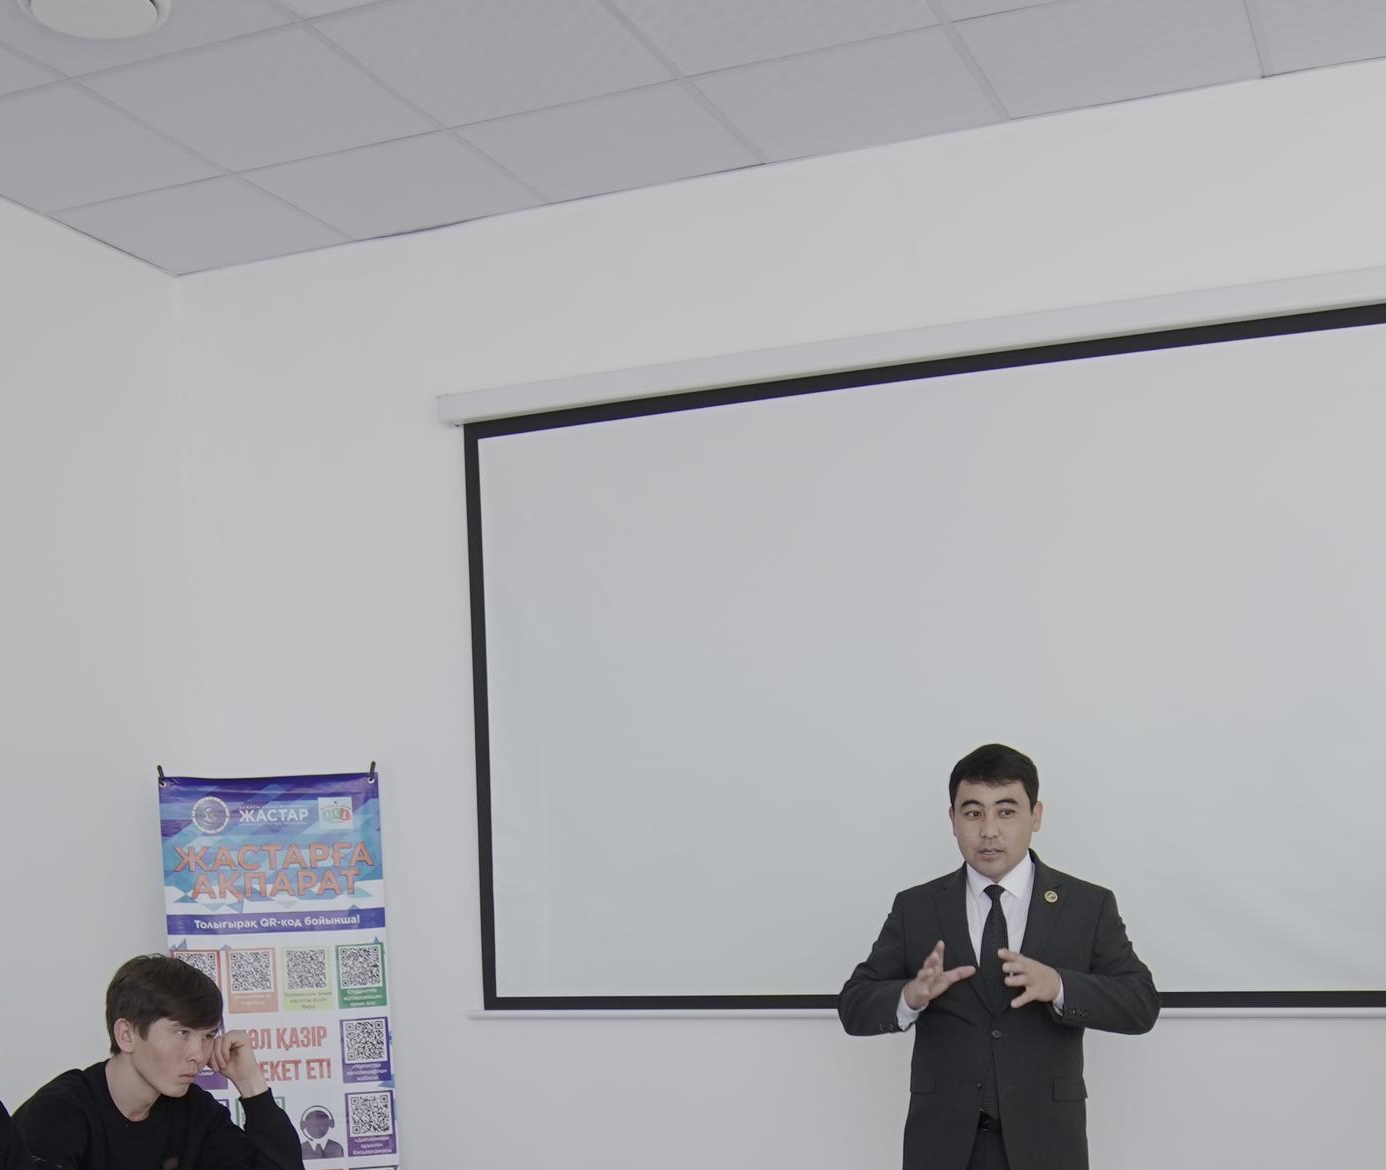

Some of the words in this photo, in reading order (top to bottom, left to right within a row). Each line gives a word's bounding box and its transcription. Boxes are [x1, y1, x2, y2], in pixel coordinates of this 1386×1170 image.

[238, 808, 309, 823] ЖАСТАР
[173, 840, 375, 873] ЖАСТАРҒА
[191, 867, 362, 903] АҚПАРАТ
[193, 918, 258, 930] Толығырақ
[260, 917, 303, 928] QR-код
[304, 914, 361, 926] бойынша!
[247, 1027, 272, 1050] ӘЛ
[276, 1026, 328, 1051] ҚАЗІР
[306, 1058, 333, 1081] ЕТ!
